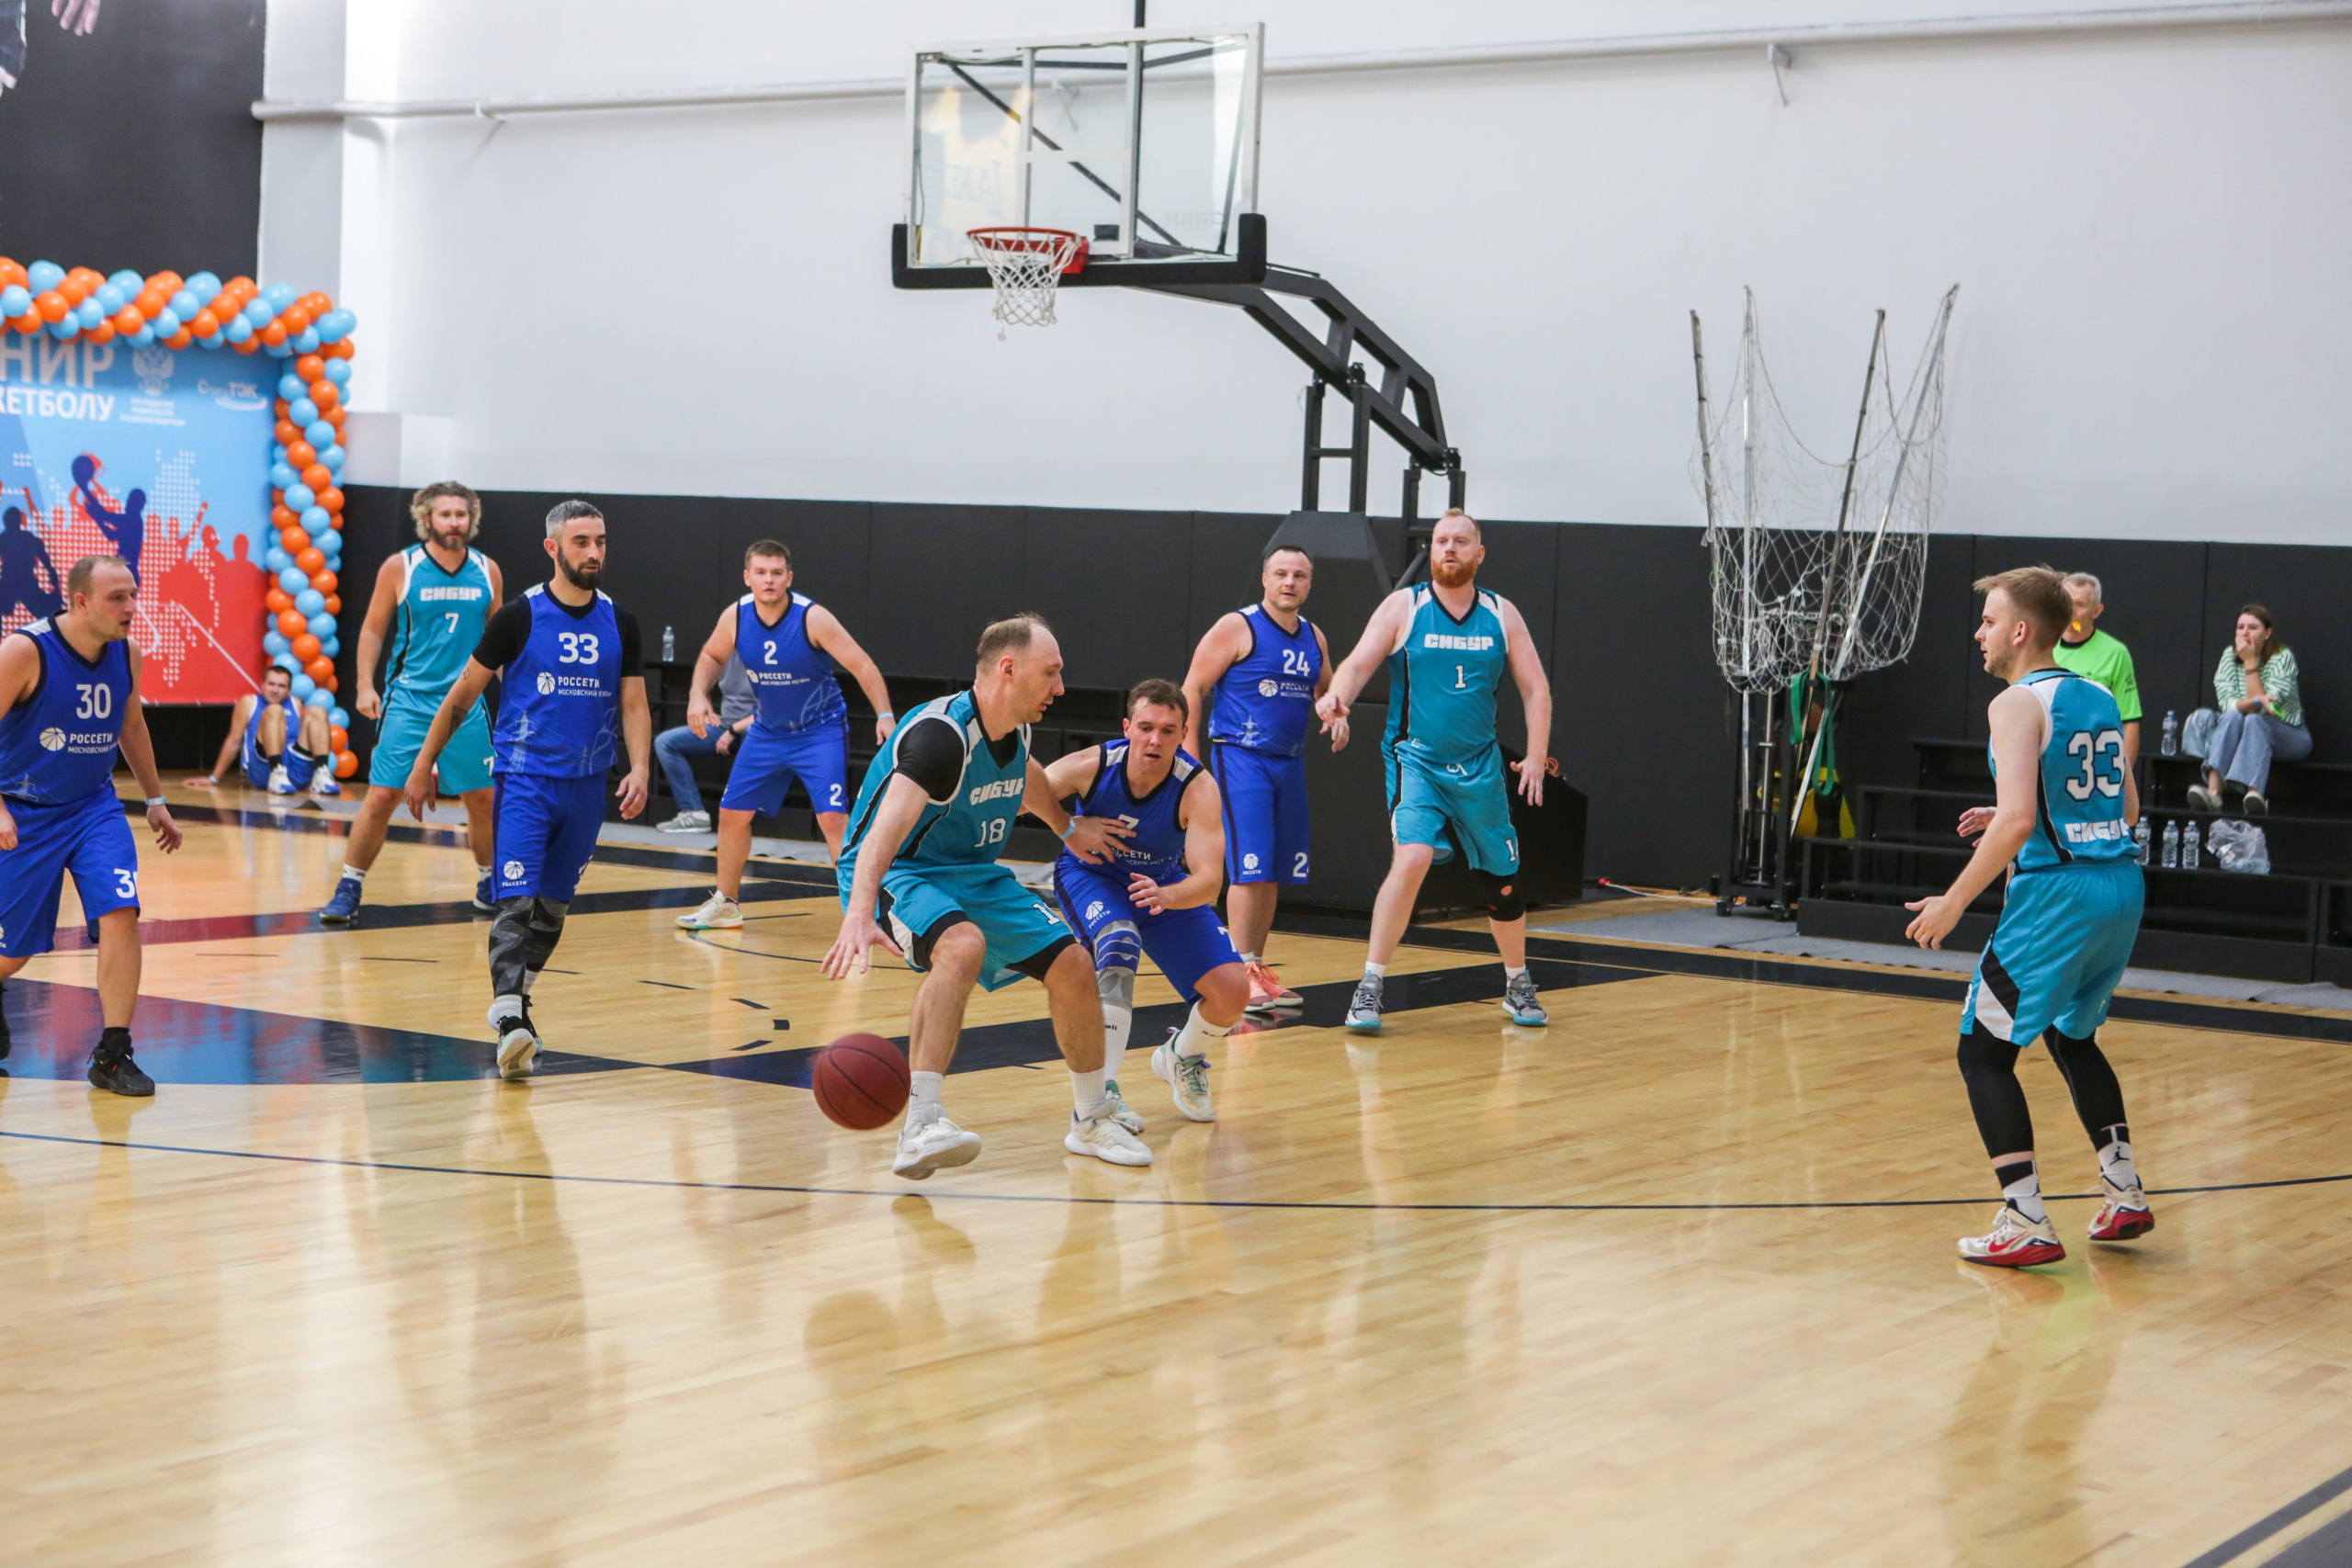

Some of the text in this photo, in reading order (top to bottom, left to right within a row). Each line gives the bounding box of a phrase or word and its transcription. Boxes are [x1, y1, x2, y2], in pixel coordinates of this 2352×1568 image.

[420, 586, 482, 602] СИБУР
[445, 613, 459, 634] 7
[559, 632, 599, 665] 33
[763, 640, 778, 665] 2
[1424, 634, 1494, 650] СИБУР
[1283, 649, 1310, 676] 24
[558, 676, 600, 688] РОССЕТИ
[758, 672, 792, 681] РОССЕТИ
[1454, 665, 1466, 689] 1
[76, 683, 111, 719] 30
[558, 688, 598, 697] МОСКОВСКИЙ
[69, 733, 113, 744] РОССЕТИ
[2066, 730, 2126, 801] 33
[830, 784, 842, 807] 2
[974, 818, 1006, 848] 18
[1293, 852, 1309, 877] 2
[1088, 909, 1111, 930] РОССЕТИ
